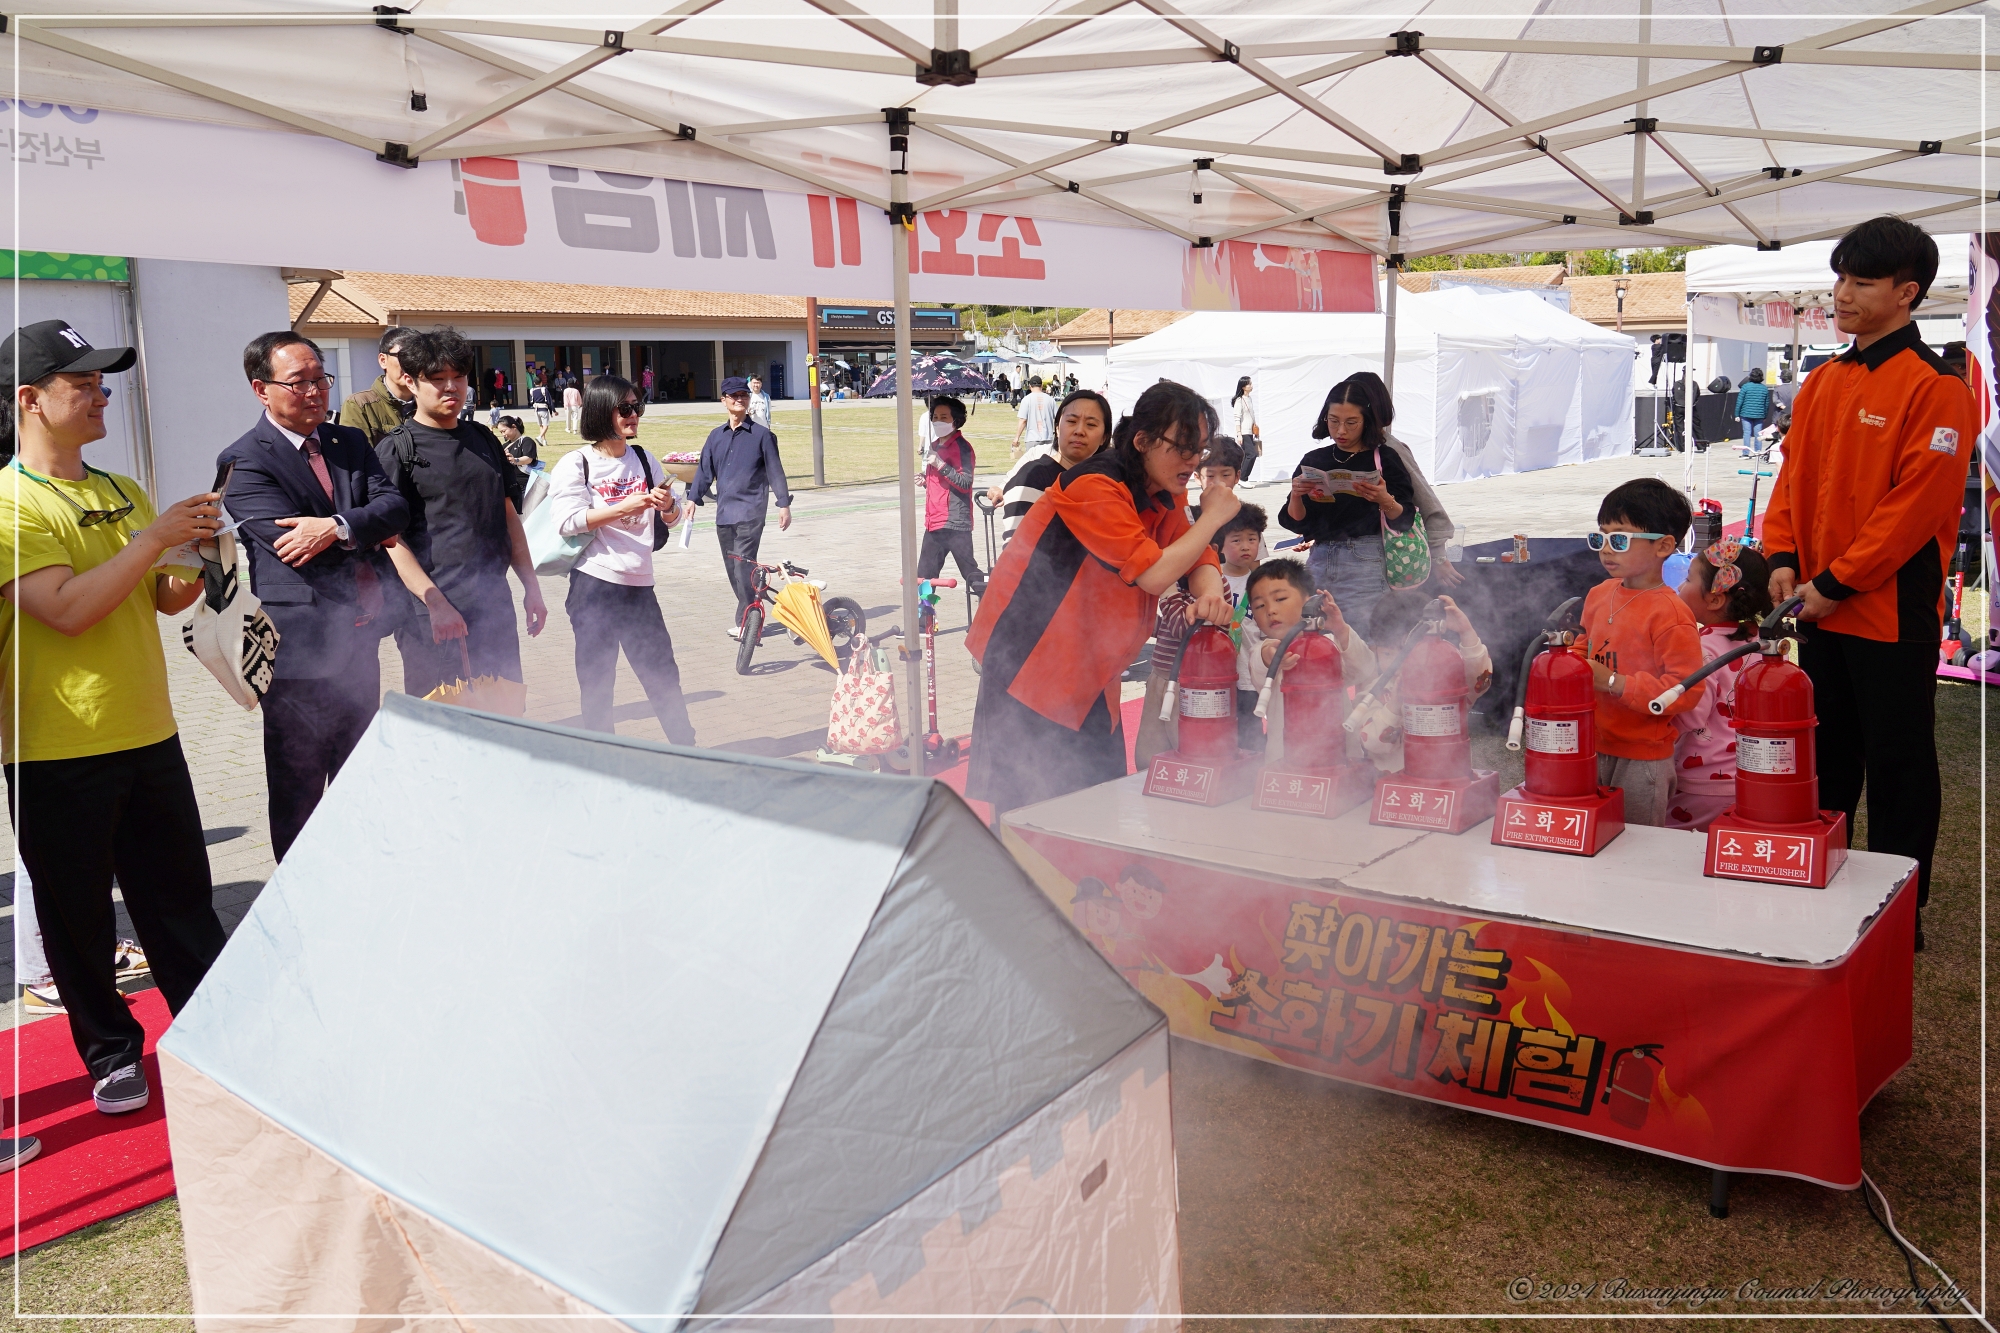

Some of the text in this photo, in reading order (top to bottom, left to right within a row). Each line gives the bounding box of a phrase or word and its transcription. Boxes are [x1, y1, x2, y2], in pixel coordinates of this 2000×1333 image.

[1506, 830, 1580, 847] FIRE EXTINGUISHER
[1719, 861, 1806, 878] FIRE EXTINGUISHER
[1281, 900, 1506, 1008] 찾아가는
[1211, 967, 1598, 1109] 소화기 체험
